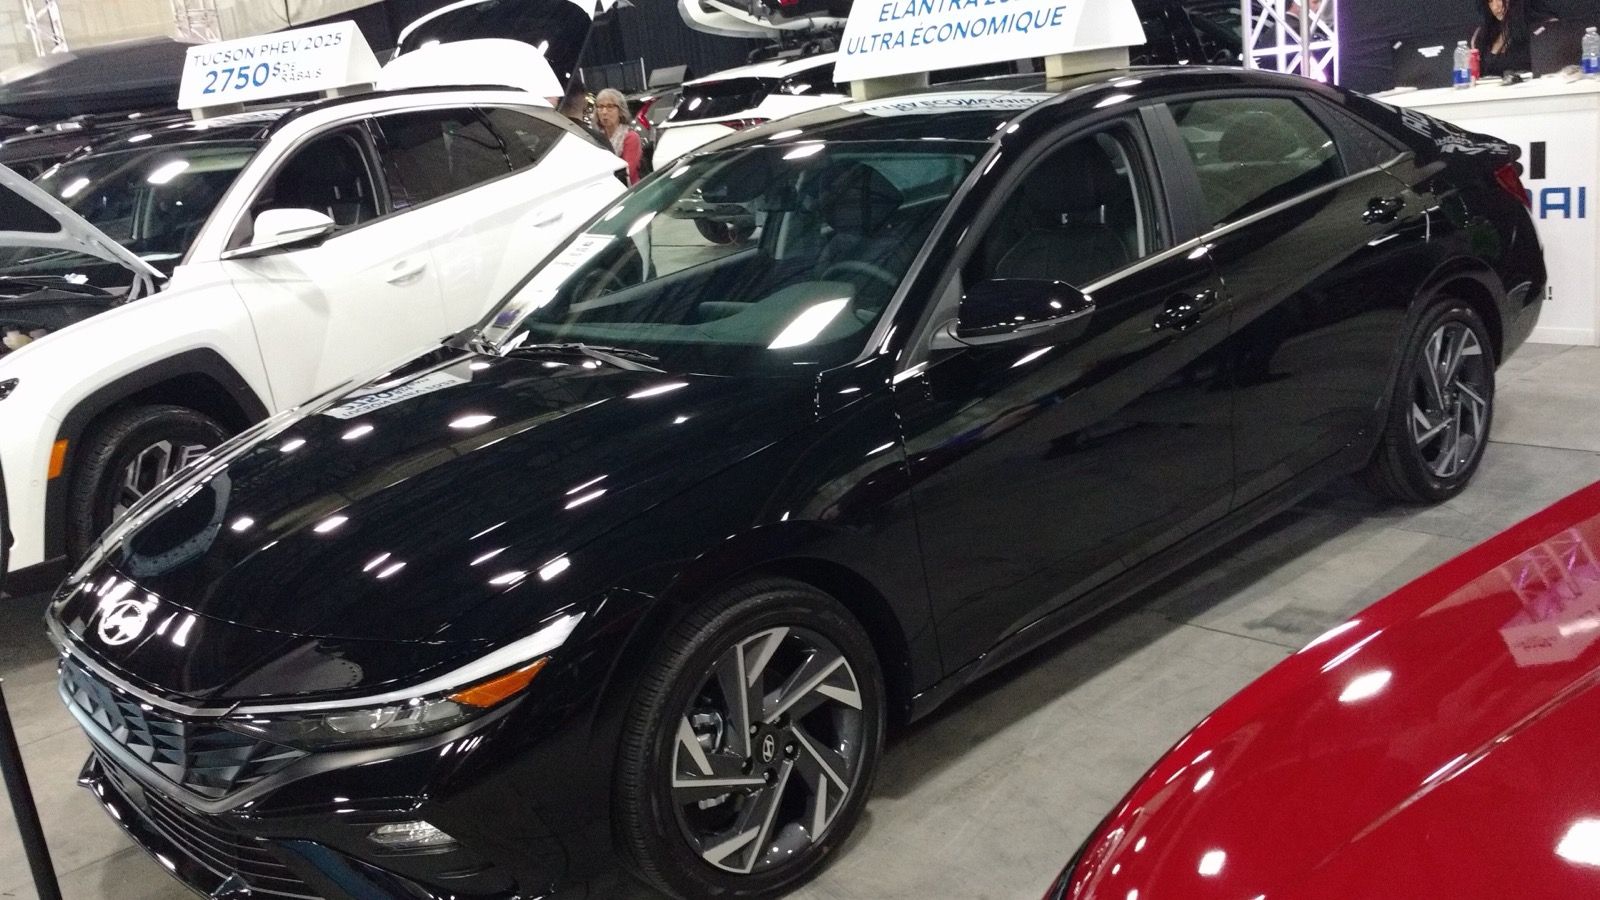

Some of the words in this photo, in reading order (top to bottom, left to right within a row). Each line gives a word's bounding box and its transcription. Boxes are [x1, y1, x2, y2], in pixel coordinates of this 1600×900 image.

[847, 31, 905, 55] ULTRA
[910, 6, 1066, 46] ÉCONOMIQUE
[194, 48, 256, 66] TUCSON
[260, 40, 300, 56] PHEV
[304, 32, 343, 50] 2025
[1525, 186, 1586, 219] AI
